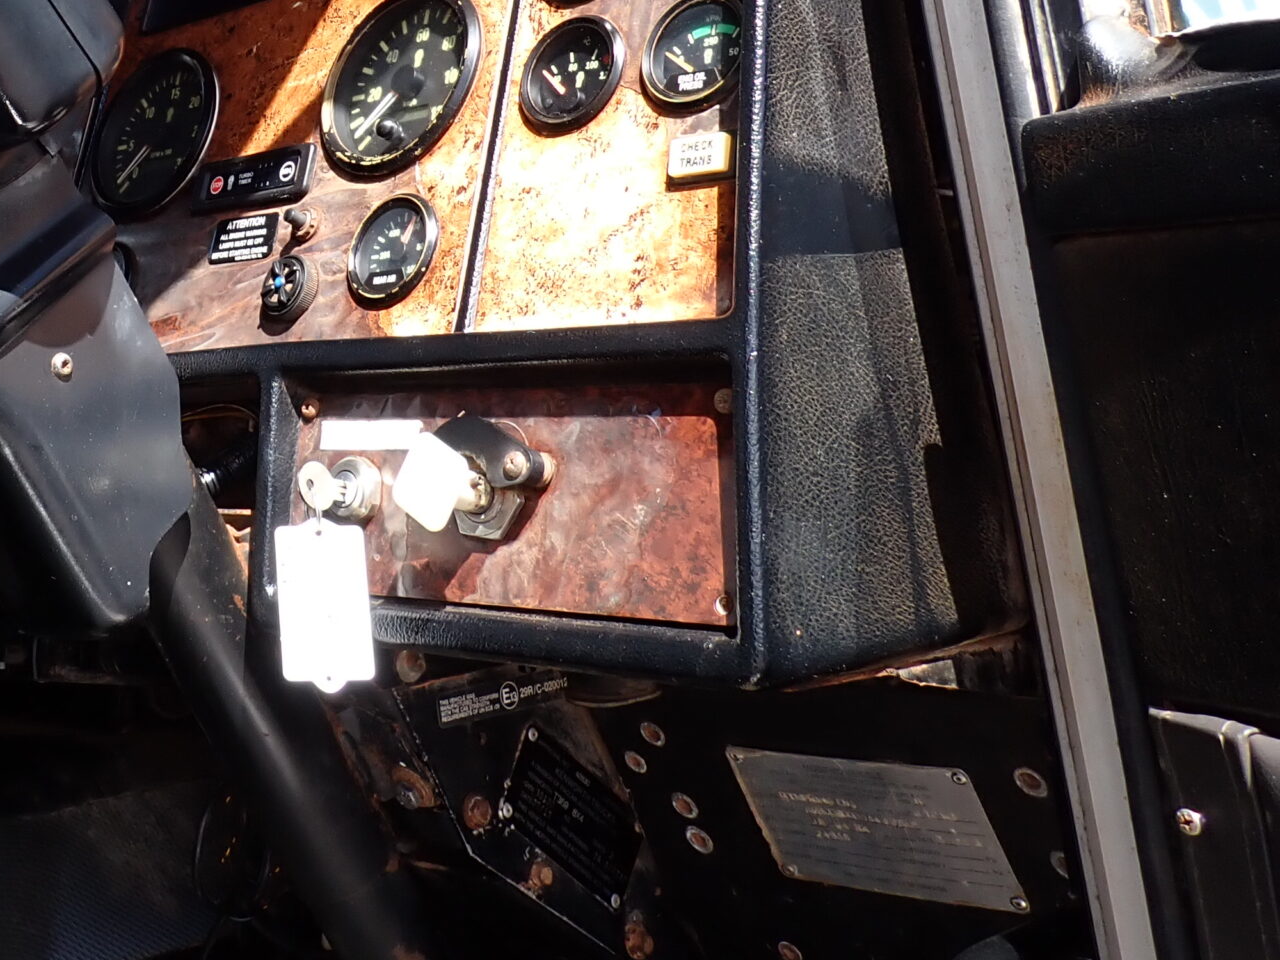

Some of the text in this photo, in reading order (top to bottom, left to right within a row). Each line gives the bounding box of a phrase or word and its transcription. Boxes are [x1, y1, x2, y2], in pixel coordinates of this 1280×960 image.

[416, 27, 430, 43] 60
[386, 49, 399, 64] 40
[585, 60, 599, 70] 100
[170, 87, 181, 100] 15
[366, 86, 383, 103] 20
[188, 95, 202, 109] 20
[145, 106, 156, 119] 10
[128, 140, 136, 152] 5
[681, 140, 713, 153] CHECK
[680, 154, 712, 168] TRANS
[238, 171, 254, 179] TURBO
[226, 216, 266, 230] ATTENTION
